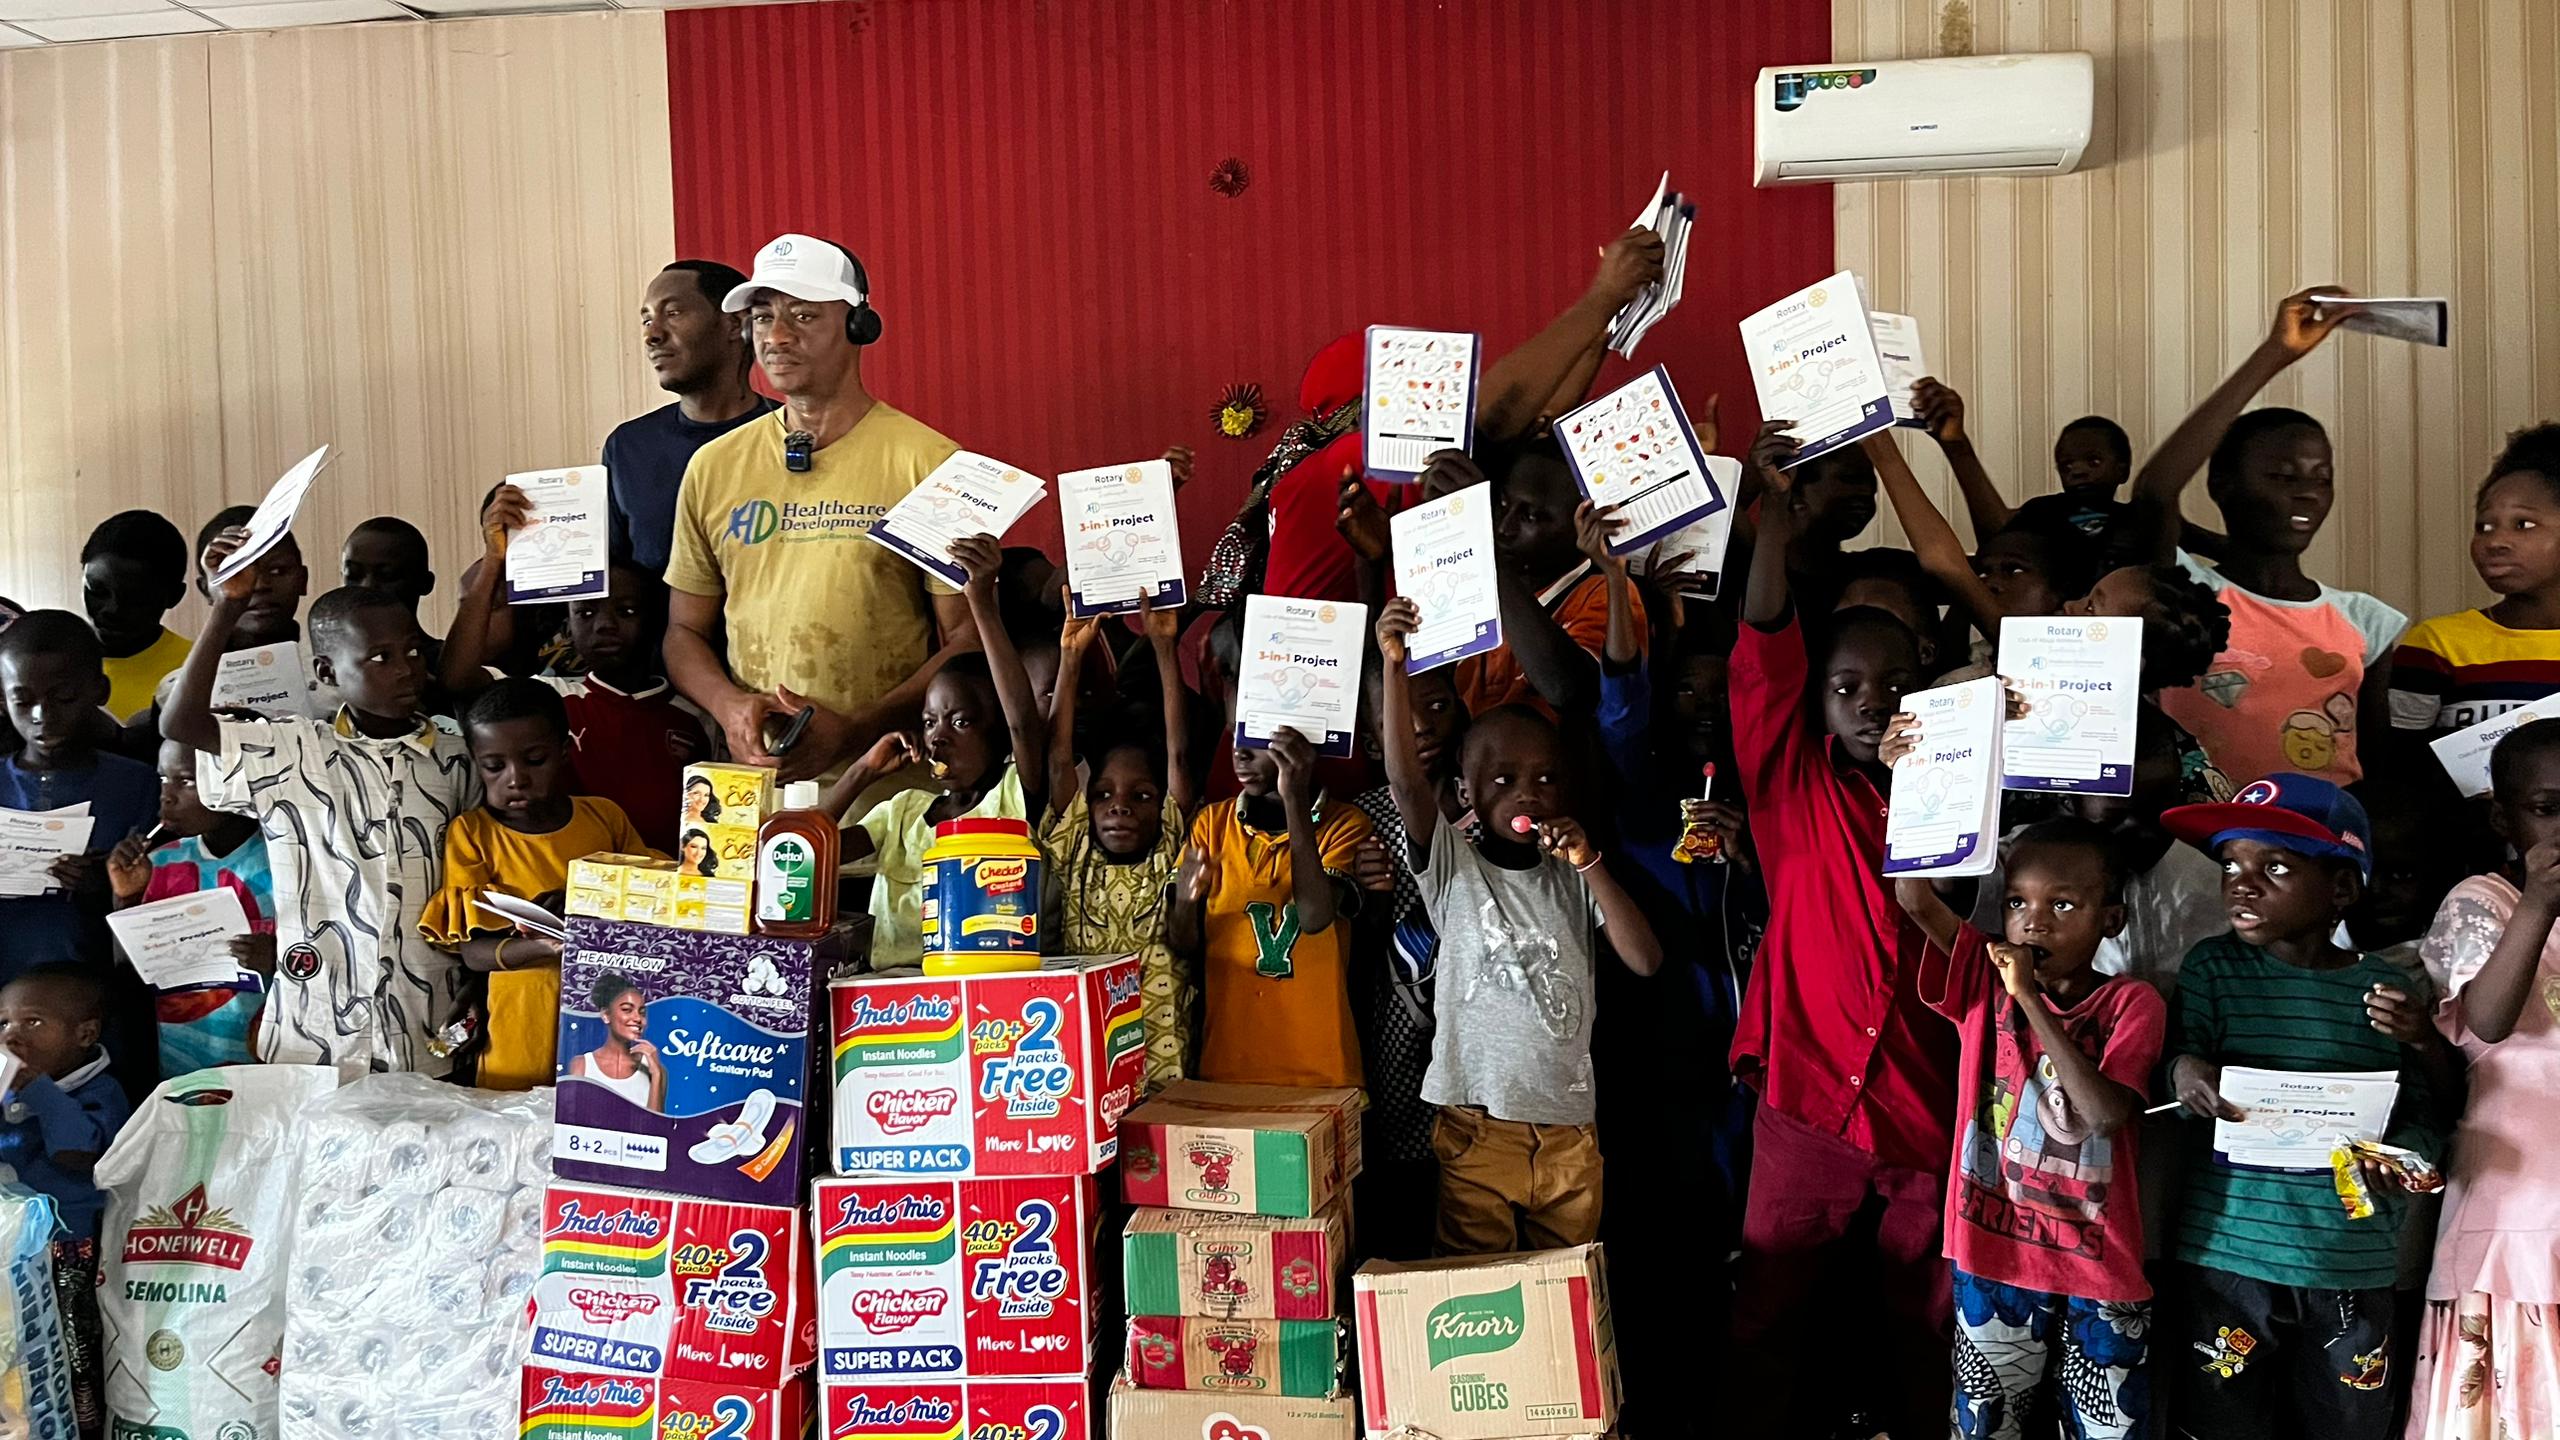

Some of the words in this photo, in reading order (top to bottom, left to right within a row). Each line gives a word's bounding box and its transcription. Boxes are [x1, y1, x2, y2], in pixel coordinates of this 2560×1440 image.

[1776, 301, 1806, 319] Rotary
[1767, 356, 1800, 376] 3-in-1
[1801, 333, 1847, 360] Project
[978, 461, 1003, 475] Rotary
[1095, 473, 1123, 484] Rotary
[933, 482, 961, 497] 3-in-1
[960, 492, 998, 513] Project
[783, 500, 887, 518] Healthcare
[1420, 505, 1447, 521] Rotary
[549, 513, 586, 523] Project
[780, 516, 876, 531] Developmen
[1079, 520, 1110, 532] 3-in-1
[1112, 514, 1154, 527] Project
[1408, 561, 1434, 578] 3-in-1
[1436, 547, 1474, 569] Project
[1286, 605, 1316, 618] Rotary
[2047, 625, 2083, 637] Rotary
[1258, 651, 1291, 663] 3-in-1
[1294, 655, 1338, 667] Project
[2017, 679, 2055, 689] 3-in-1
[2059, 679, 2112, 692] Project
[247, 690, 288, 704] Project
[1929, 697, 1955, 709] Rotary
[1907, 754, 1932, 768] 3-in-1
[1935, 748, 1972, 763] Project
[9, 817, 42, 827] Rotary
[773, 850, 803, 861] Dettol
[179, 926, 225, 942] Project
[290, 951, 314, 971] 79
[578, 951, 624, 967] HEAVY
[624, 956, 664, 971] FLOW
[732, 995, 769, 1007] COTTON
[770, 999, 794, 1009] FEEL
[972, 1020, 1022, 1041] 40+
[1020, 1001, 1057, 1051] 2
[662, 1028, 774, 1067] Softcare
[976, 1040, 1007, 1052] packs
[862, 1049, 895, 1062] Instant
[896, 1048, 936, 1060] Noodles
[1016, 1051, 1058, 1066] packs
[709, 1062, 751, 1077] Sanitary
[751, 1067, 773, 1079] Pad
[983, 1061, 1068, 1095] Free
[2280, 1082, 2324, 1091] Rotary
[867, 1090, 952, 1115] Chicken
[1009, 1099, 1056, 1112] Inside
[888, 1111, 925, 1126] Flavor
[2292, 1108, 2356, 1117] Project
[985, 1136, 1023, 1153] More
[850, 1150, 904, 1169] SUPER
[909, 1148, 963, 1168] PACK
[1199, 1190, 1228, 1201] Gino
[184, 1197, 204, 1223] H
[965, 1222, 1015, 1242] 40+
[1013, 1202, 1053, 1253] 2
[1967, 1188, 2103, 1258] FRIENDS
[124, 1235, 241, 1262] HONEYWELL
[675, 1245, 728, 1266] 40+
[724, 1232, 765, 1278] 2
[968, 1241, 1001, 1253] packs
[1206, 1242, 1239, 1254] Gino
[850, 1250, 884, 1263] Instant
[885, 1249, 927, 1261] Noodles
[1009, 1253, 1053, 1268] packs
[561, 1257, 594, 1272] Instant
[596, 1260, 637, 1274] Noodles
[677, 1263, 711, 1274] packs
[720, 1277, 764, 1289] packs
[975, 1262, 1062, 1296] Free
[125, 1280, 227, 1303] SEMOLINA
[686, 1281, 774, 1312] Free
[570, 1290, 655, 1311] Chicken
[854, 1291, 941, 1313] Chicken
[1001, 1300, 1050, 1314] Inside
[708, 1315, 756, 1330] Inside
[874, 1312, 915, 1326] Flavor
[1430, 1311, 1520, 1340] Knorr
[541, 1333, 596, 1360] SUPER
[600, 1341, 654, 1369] PACK
[977, 1335, 1015, 1351] More
[676, 1343, 715, 1362] More
[833, 1351, 893, 1370] SUPER
[899, 1349, 955, 1368] PACK
[1449, 1373, 1486, 1384] SEASONING
[27, 1346, 57, 1440] OLDEN
[1450, 1383, 1508, 1412] CUBES
[661, 1412, 712, 1431] 40+
[707, 1398, 749, 1440] 2
[972, 1425, 1024, 1440] 40+
[1026, 1408, 1062, 1440] 2
[548, 1428, 582, 1440] Instant
[584, 1430, 623, 1440] Noodles
[664, 1431, 696, 1440] packs
